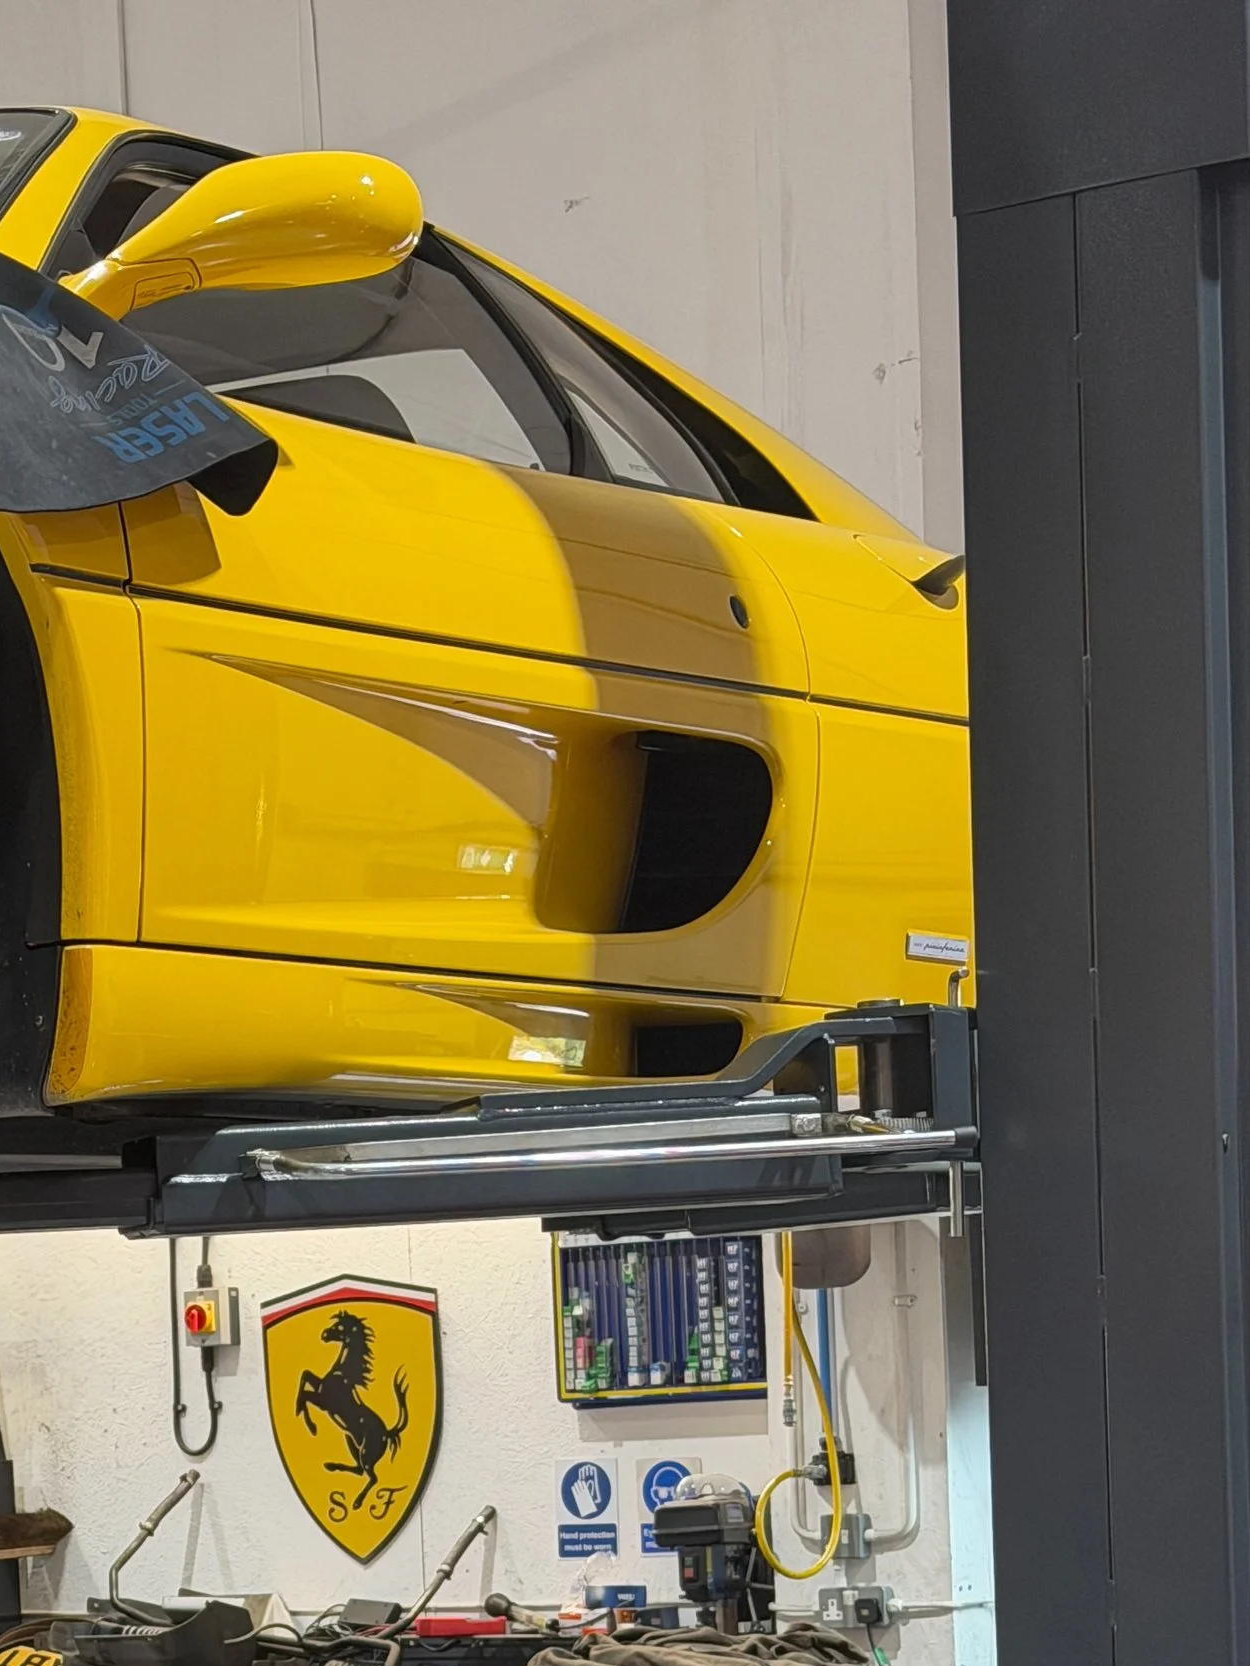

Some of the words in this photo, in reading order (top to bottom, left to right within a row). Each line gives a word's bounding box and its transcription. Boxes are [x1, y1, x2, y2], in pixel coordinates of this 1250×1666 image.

[49, 343, 171, 414] Racing
[91, 391, 231, 464] LASER
[104, 393, 159, 426] TOOLS
[328, 1490, 348, 1523] S
[369, 1484, 408, 1520] F
[560, 1531, 578, 1539] Hand
[579, 1531, 616, 1541] protection
[583, 1543, 593, 1551] be
[593, 1543, 612, 1551] worn
